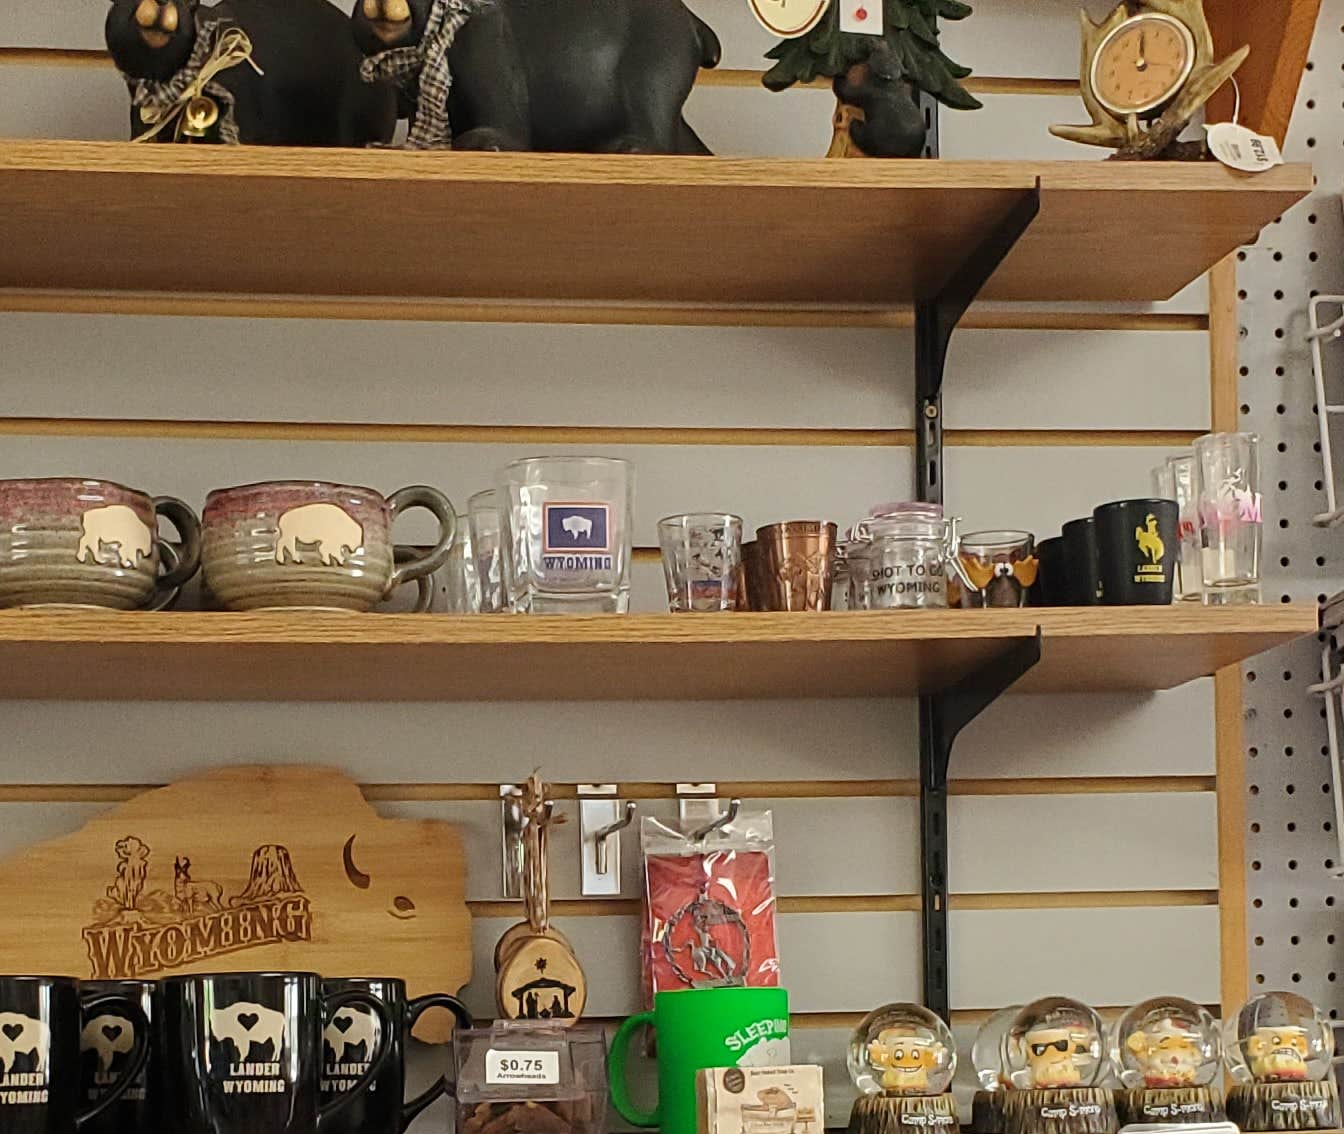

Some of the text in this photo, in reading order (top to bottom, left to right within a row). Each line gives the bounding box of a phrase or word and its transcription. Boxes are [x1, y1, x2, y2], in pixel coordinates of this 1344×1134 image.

[543, 556, 612, 571] WYOMING
[908, 565, 926, 577] TO
[877, 582, 941, 595] WYOMING
[86, 900, 310, 979] WYOMING
[230, 1062, 280, 1076] LANDER
[499, 1058, 543, 1072] $0.75
[496, 1072, 547, 1080] Arrowheads
[223, 1079, 285, 1093] WYOMING
